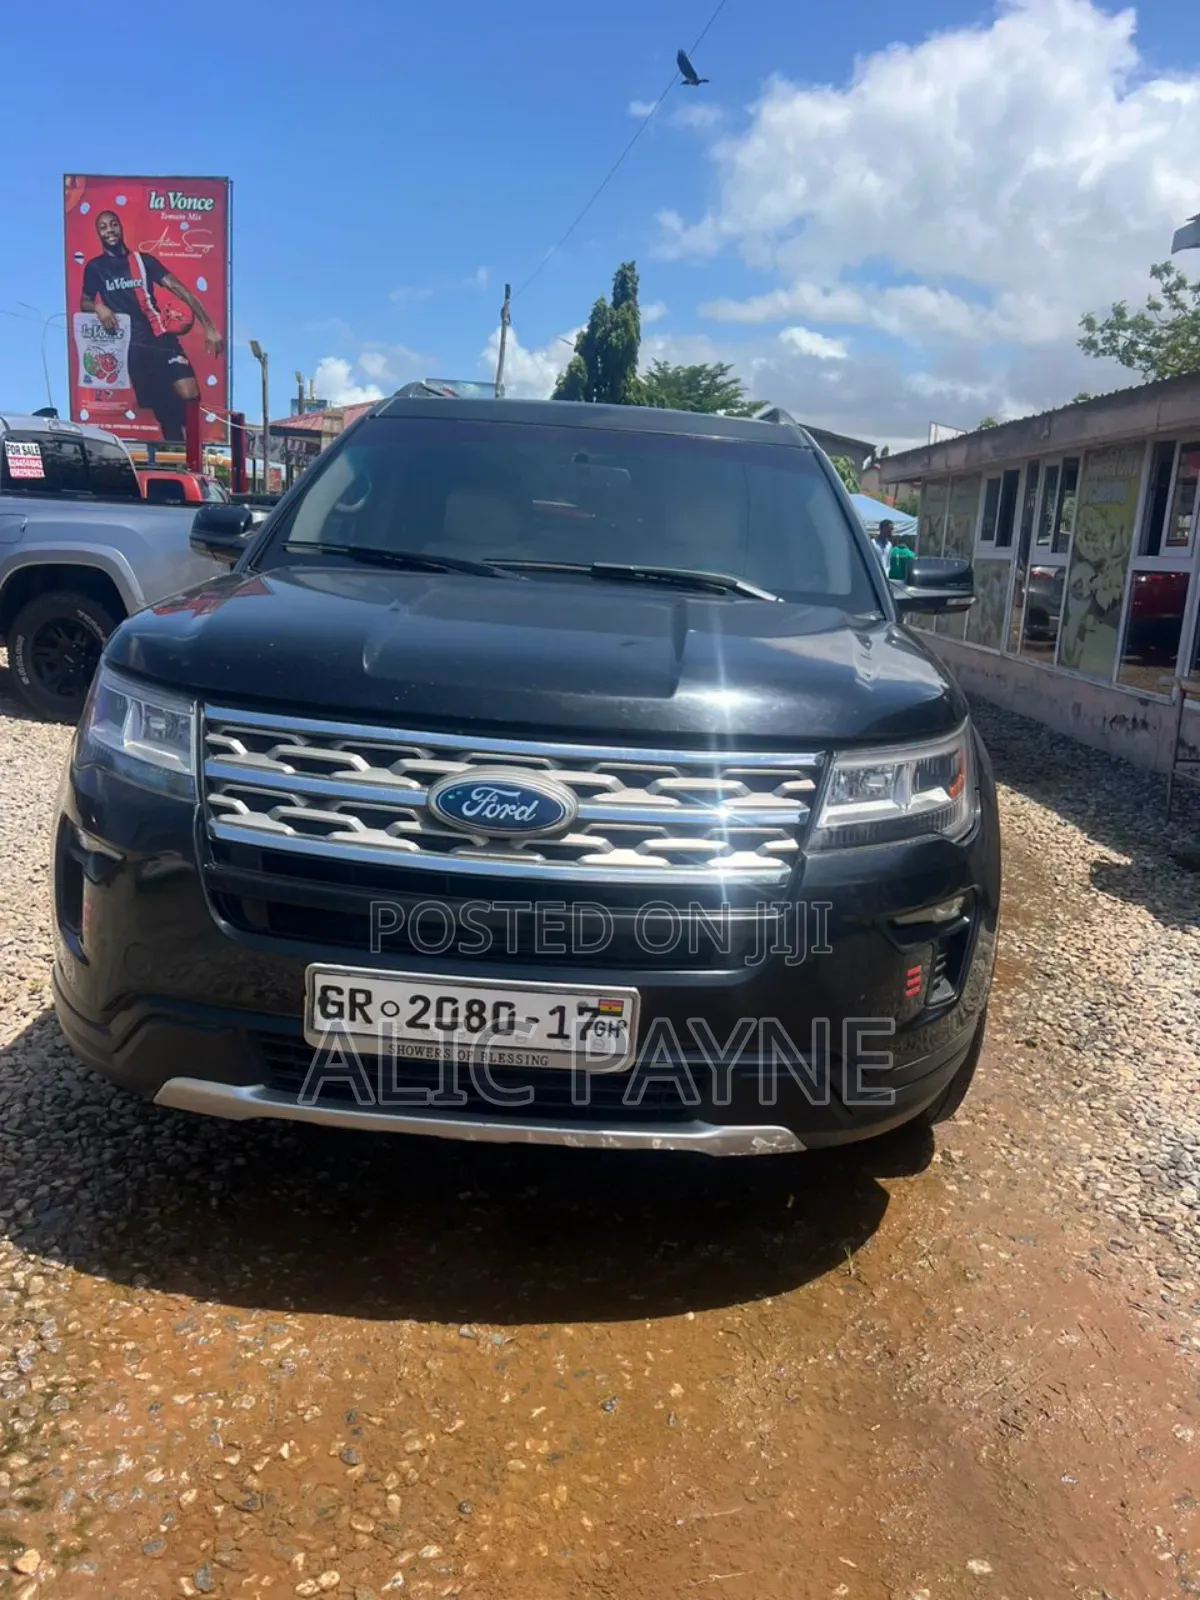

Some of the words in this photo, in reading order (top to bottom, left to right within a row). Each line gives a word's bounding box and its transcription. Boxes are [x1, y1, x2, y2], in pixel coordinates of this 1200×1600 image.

[149, 190, 165, 210] la
[167, 191, 215, 211] Vonce
[6, 444, 21, 455] FOR
[21, 445, 40, 456] SALE
[461, 786, 539, 821] Ford
[318, 985, 373, 1024] GR
[388, 1043, 451, 1059] SHOWERS
[457, 1050, 473, 1061] OF
[480, 1051, 549, 1066] BLESSING
